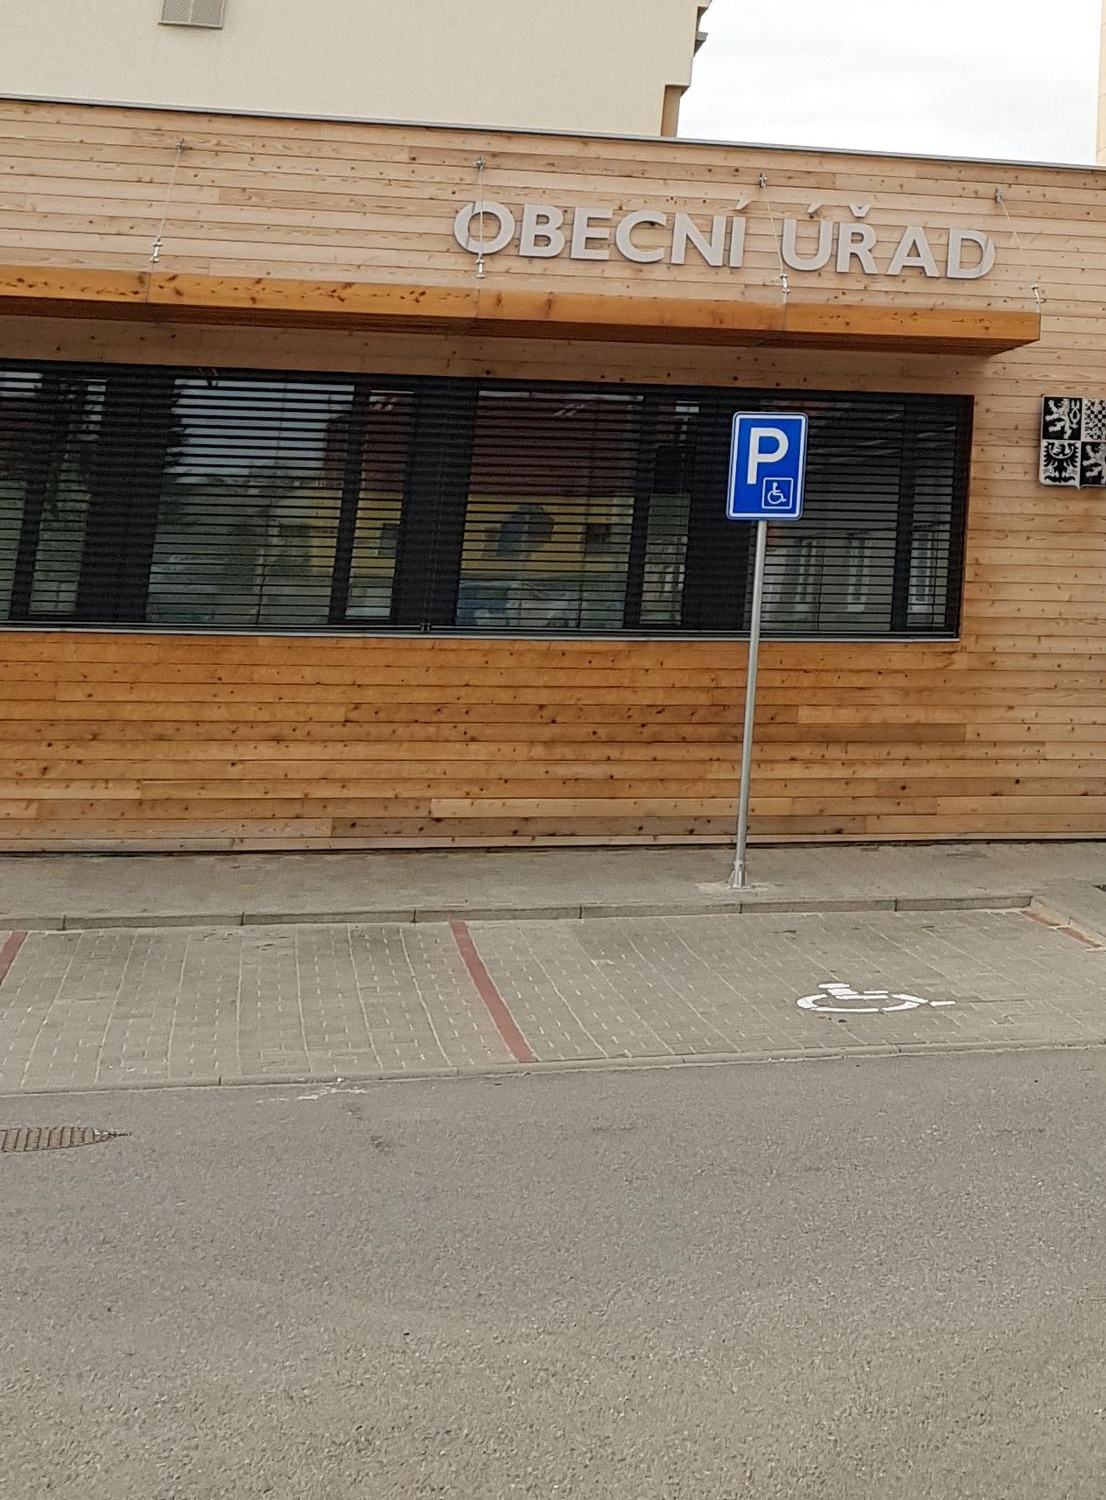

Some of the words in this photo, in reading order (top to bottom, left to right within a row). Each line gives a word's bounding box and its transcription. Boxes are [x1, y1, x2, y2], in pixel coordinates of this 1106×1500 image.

[454, 200, 751, 268] OBECNÍ
[781, 203, 996, 279] ÚŘAD
[747, 427, 789, 484] P
